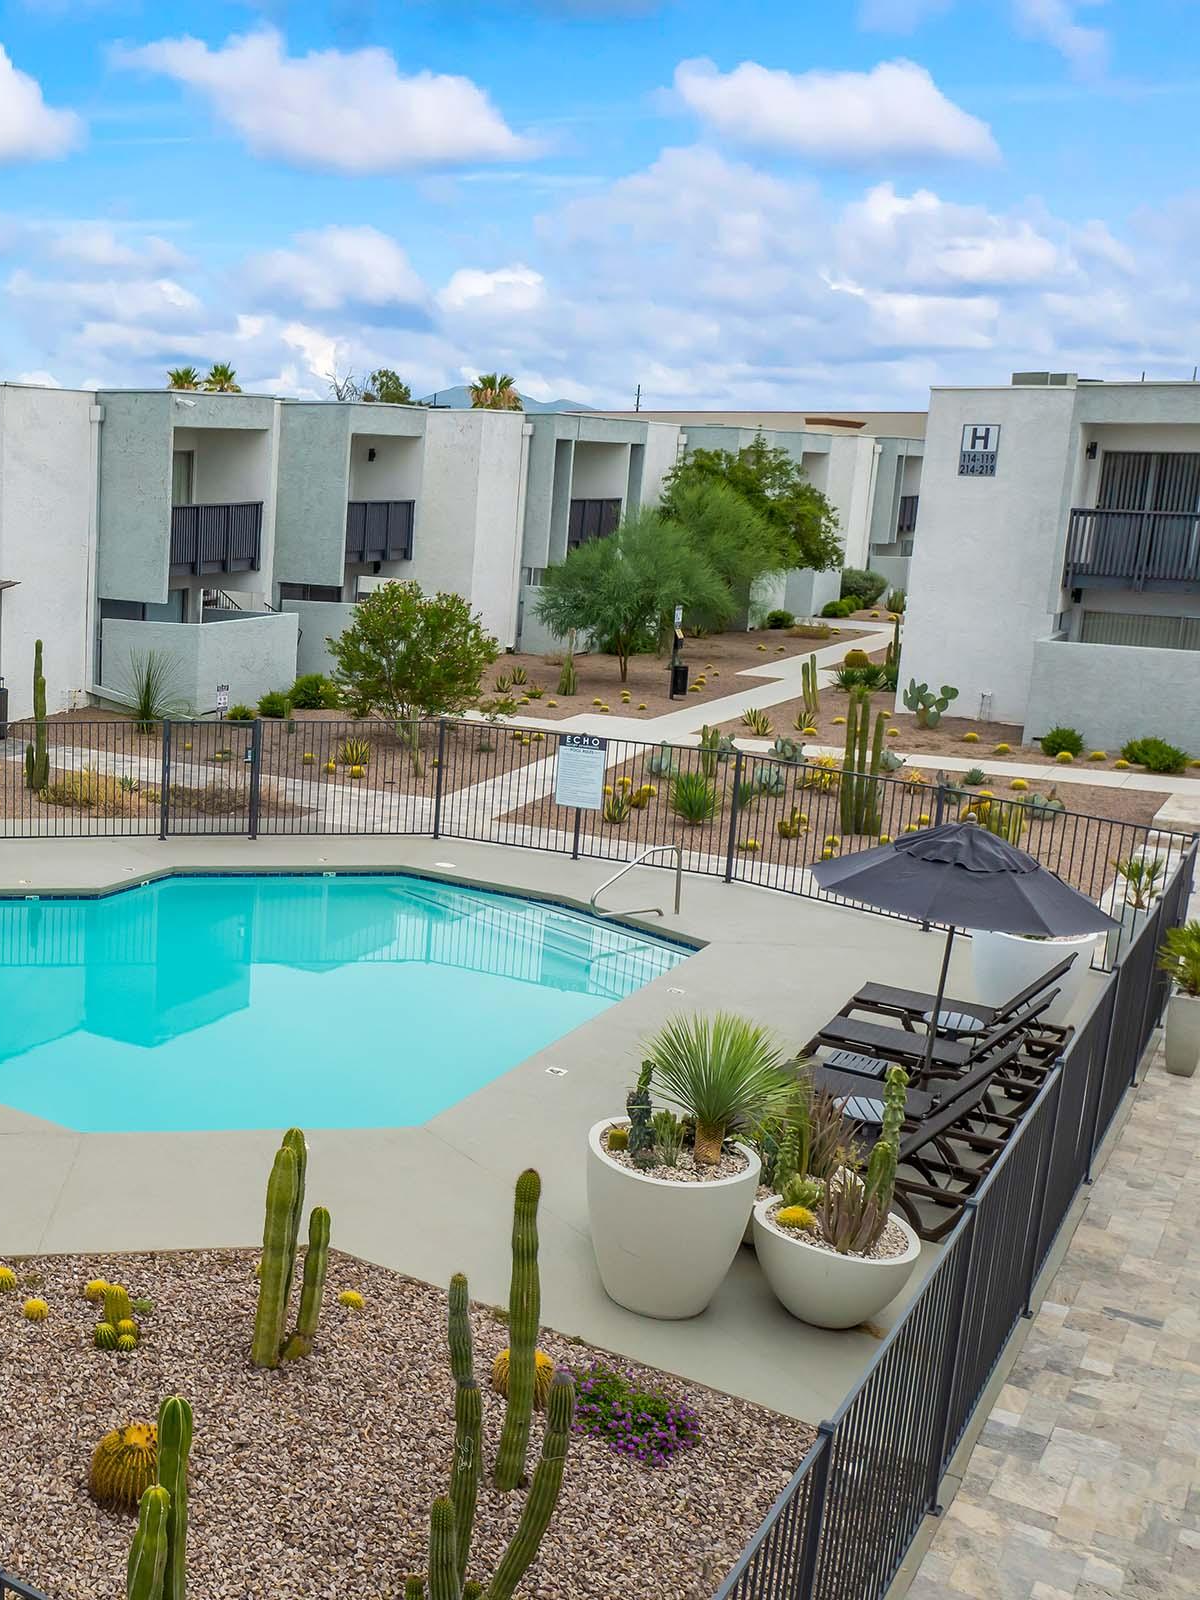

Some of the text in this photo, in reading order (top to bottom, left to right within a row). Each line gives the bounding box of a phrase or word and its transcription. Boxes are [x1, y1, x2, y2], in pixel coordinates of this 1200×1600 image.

[970, 427, 990, 450] H
[962, 453, 996, 464] 114-119
[959, 464, 995, 474] 214-219
[566, 735, 600, 746] ECHO
